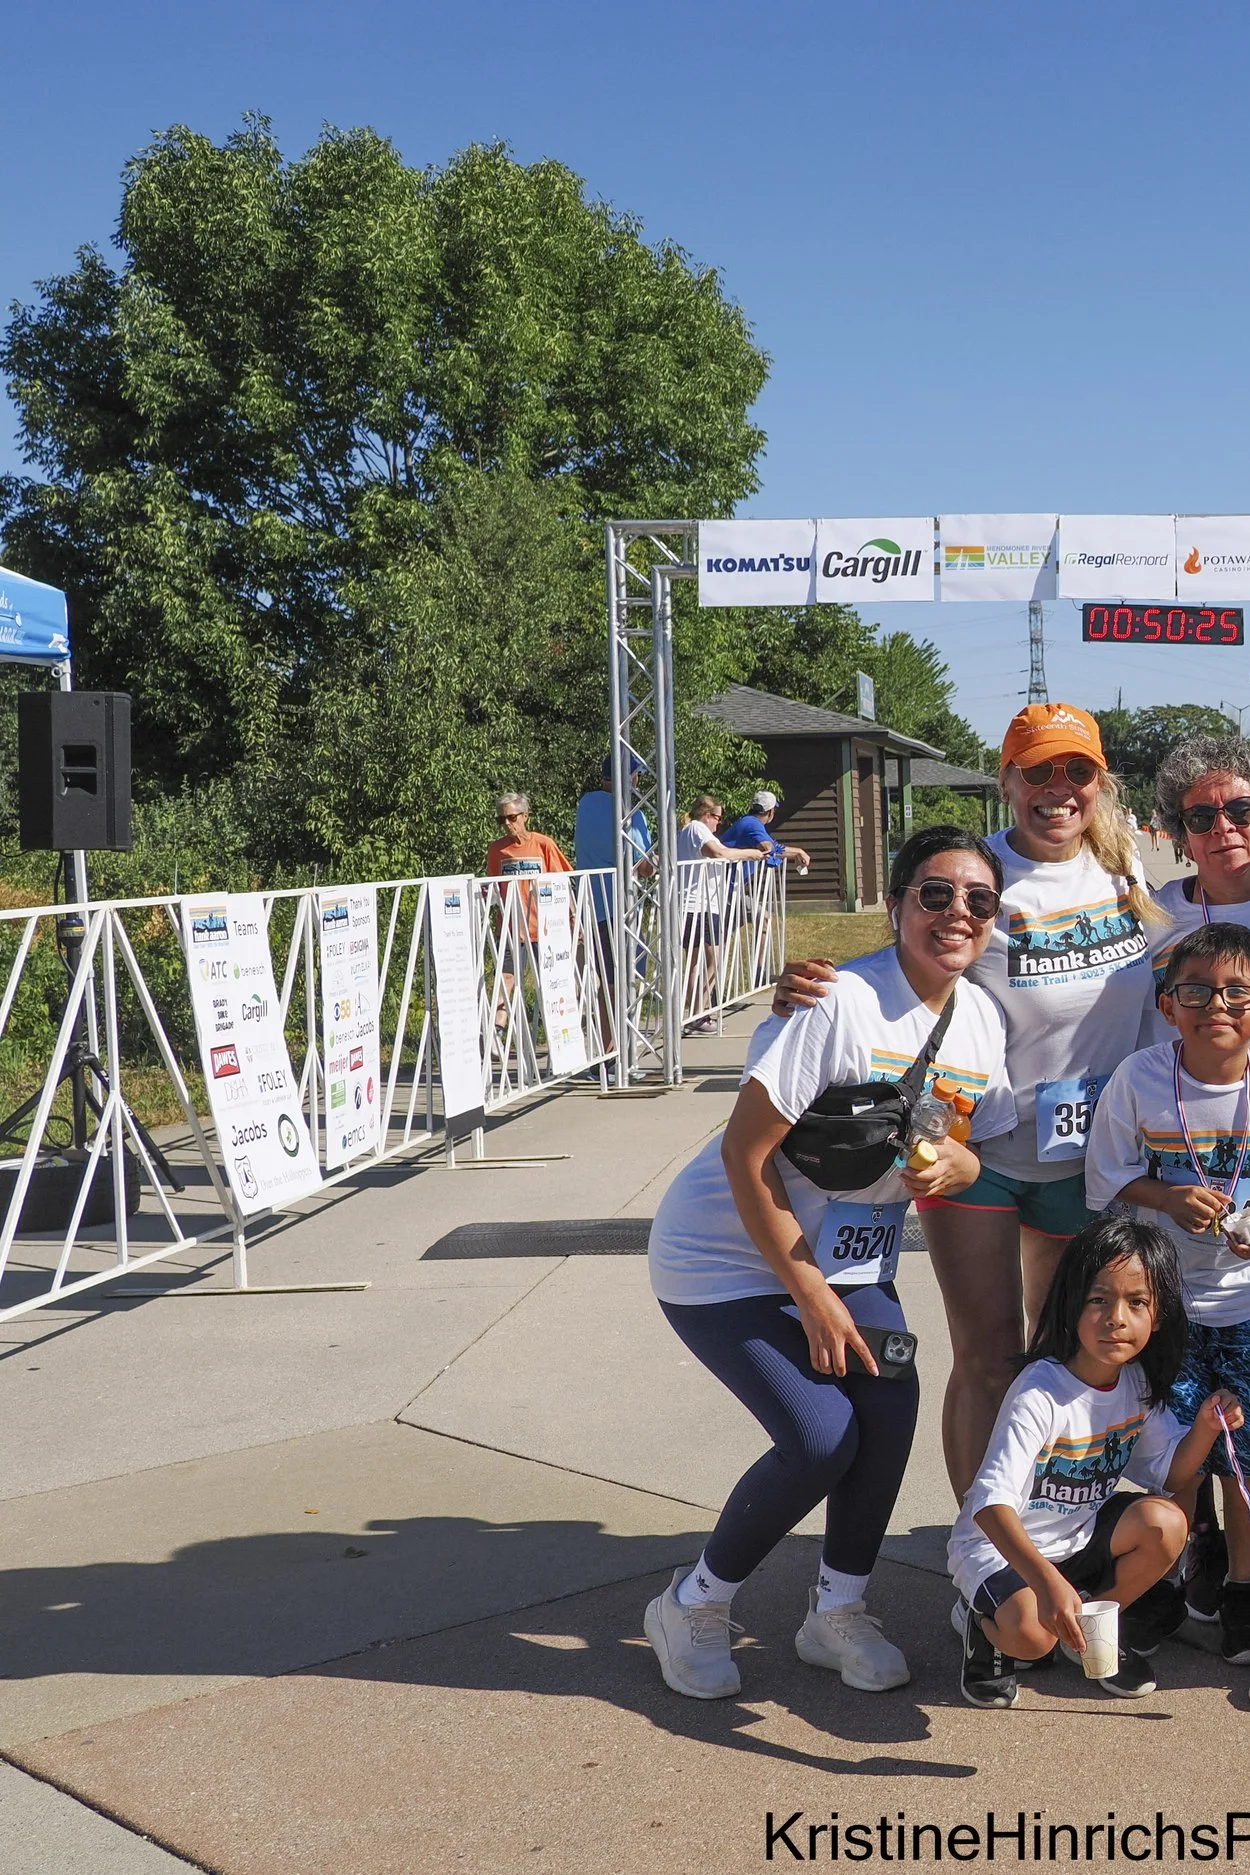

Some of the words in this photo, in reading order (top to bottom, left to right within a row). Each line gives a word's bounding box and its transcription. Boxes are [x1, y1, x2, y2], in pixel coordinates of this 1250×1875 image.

[706, 553, 811, 573] KOMATSU
[822, 549, 922, 584] Cargill
[986, 551, 1052, 565] VALLEY
[1077, 552, 1169, 569] RegalRexnord
[1088, 607, 1239, 642] 00:50:25
[233, 920, 259, 937] Teams
[1019, 949, 1085, 975] hank
[1088, 933, 1148, 966] aaron
[210, 960, 228, 980] ATC
[1008, 976, 1040, 988] State
[1041, 973, 1069, 986] Trail
[1080, 967, 1106, 981] 2023
[1108, 961, 1124, 975] 5K
[241, 999, 269, 1023] Cargill
[328, 1053, 349, 1075] meijer
[260, 1068, 288, 1093] FOLEY
[231, 1119, 268, 1148] Jacobs
[832, 1223, 897, 1261] 3520
[1040, 1476, 1103, 1503] hank
